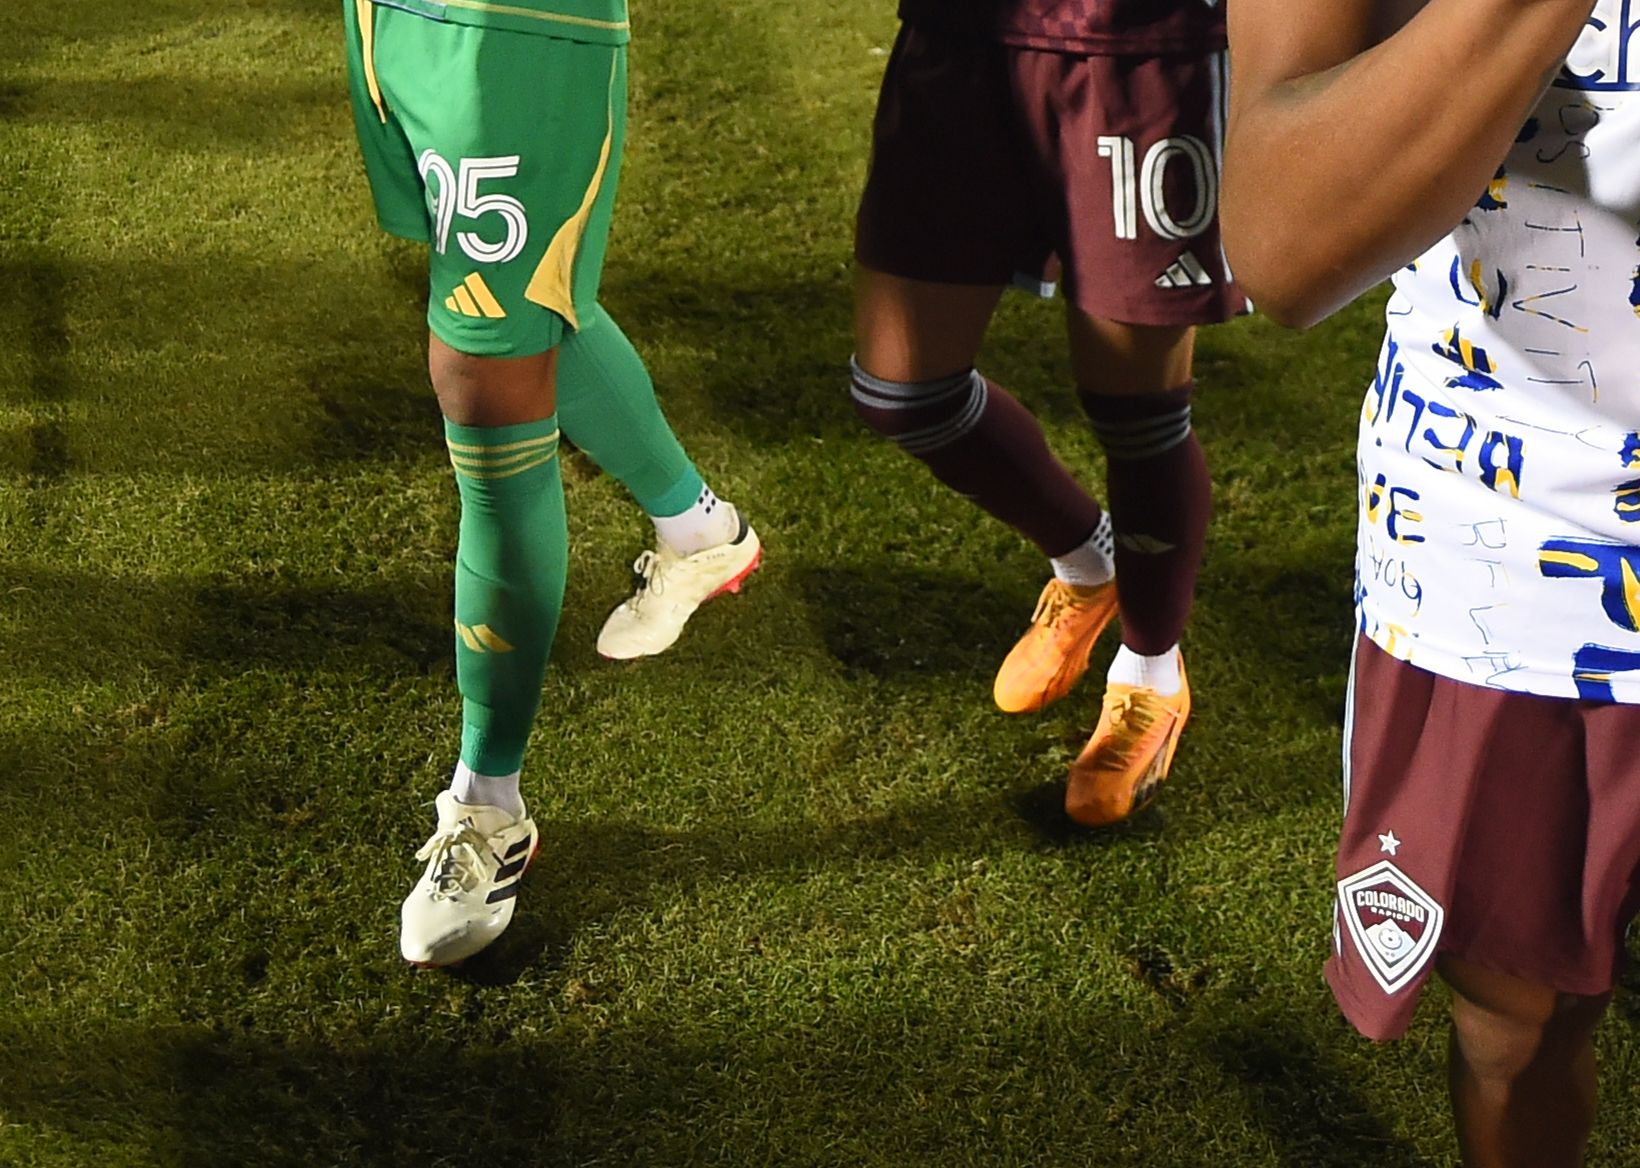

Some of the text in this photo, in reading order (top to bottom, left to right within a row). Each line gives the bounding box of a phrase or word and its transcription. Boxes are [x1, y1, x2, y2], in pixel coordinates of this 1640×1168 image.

[418, 148, 528, 263] 95
[1097, 135, 1218, 240] 10
[1356, 890, 1425, 923] COLORADO
